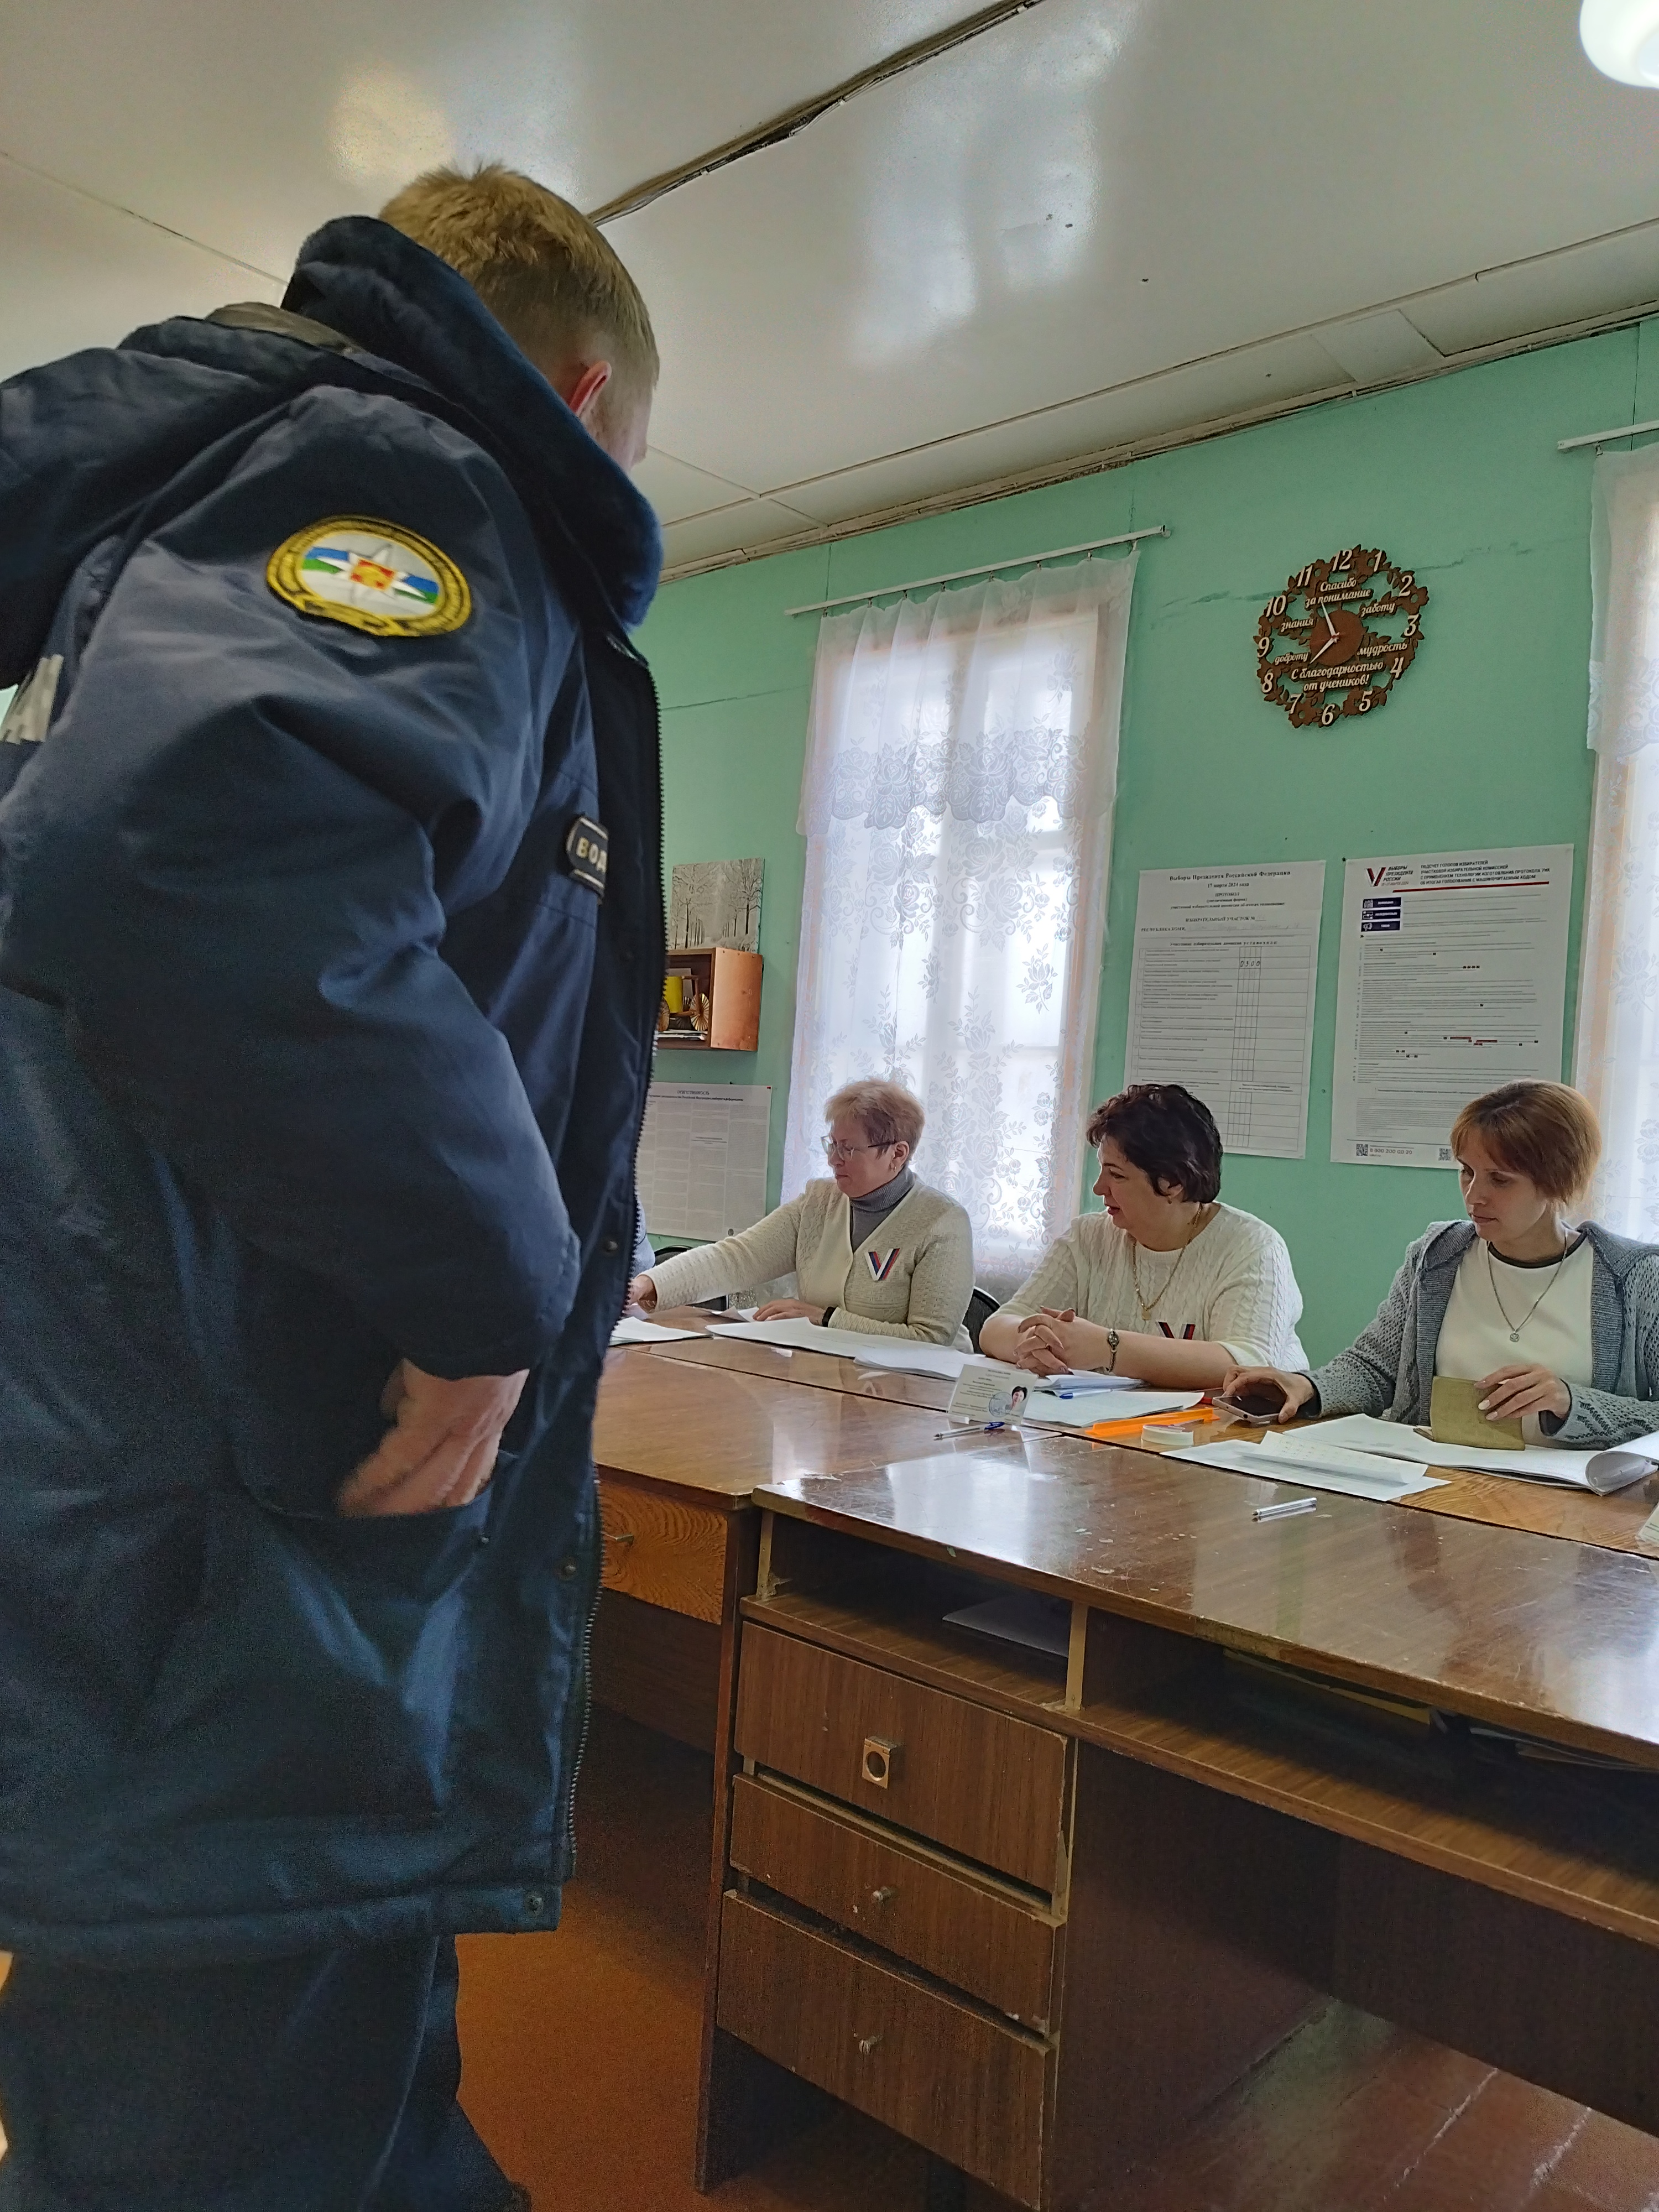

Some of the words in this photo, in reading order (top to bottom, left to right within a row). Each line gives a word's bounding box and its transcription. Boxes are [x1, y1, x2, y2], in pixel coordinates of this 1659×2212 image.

[1332, 550, 1353, 571] 12
[1374, 551, 1382, 572] 1
[1297, 565, 1313, 587] 11
[1320, 577, 1357, 592] Спасибо
[1399, 575, 1412, 597] 2
[1265, 595, 1286, 617] 10
[1305, 597, 1316, 608] за
[1318, 589, 1371, 604] понимание
[1361, 602, 1395, 617] заботу
[1281, 618, 1313, 632] знания
[1404, 614, 1419, 637] 3
[1258, 637, 1270, 658] 9
[1357, 642, 1407, 657] мудрость
[1275, 652, 1308, 665] доброту
[1390, 657, 1404, 679] 4
[1291, 669, 1298, 680] С
[1300, 661, 1383, 679] благодарностью
[1262, 672, 1273, 693] 8
[1303, 682, 1318, 691] от
[1319, 674, 1370, 692] учеников!
[1290, 694, 1302, 714] 7
[1359, 691, 1373, 712] 5
[1322, 704, 1335, 725] 6
